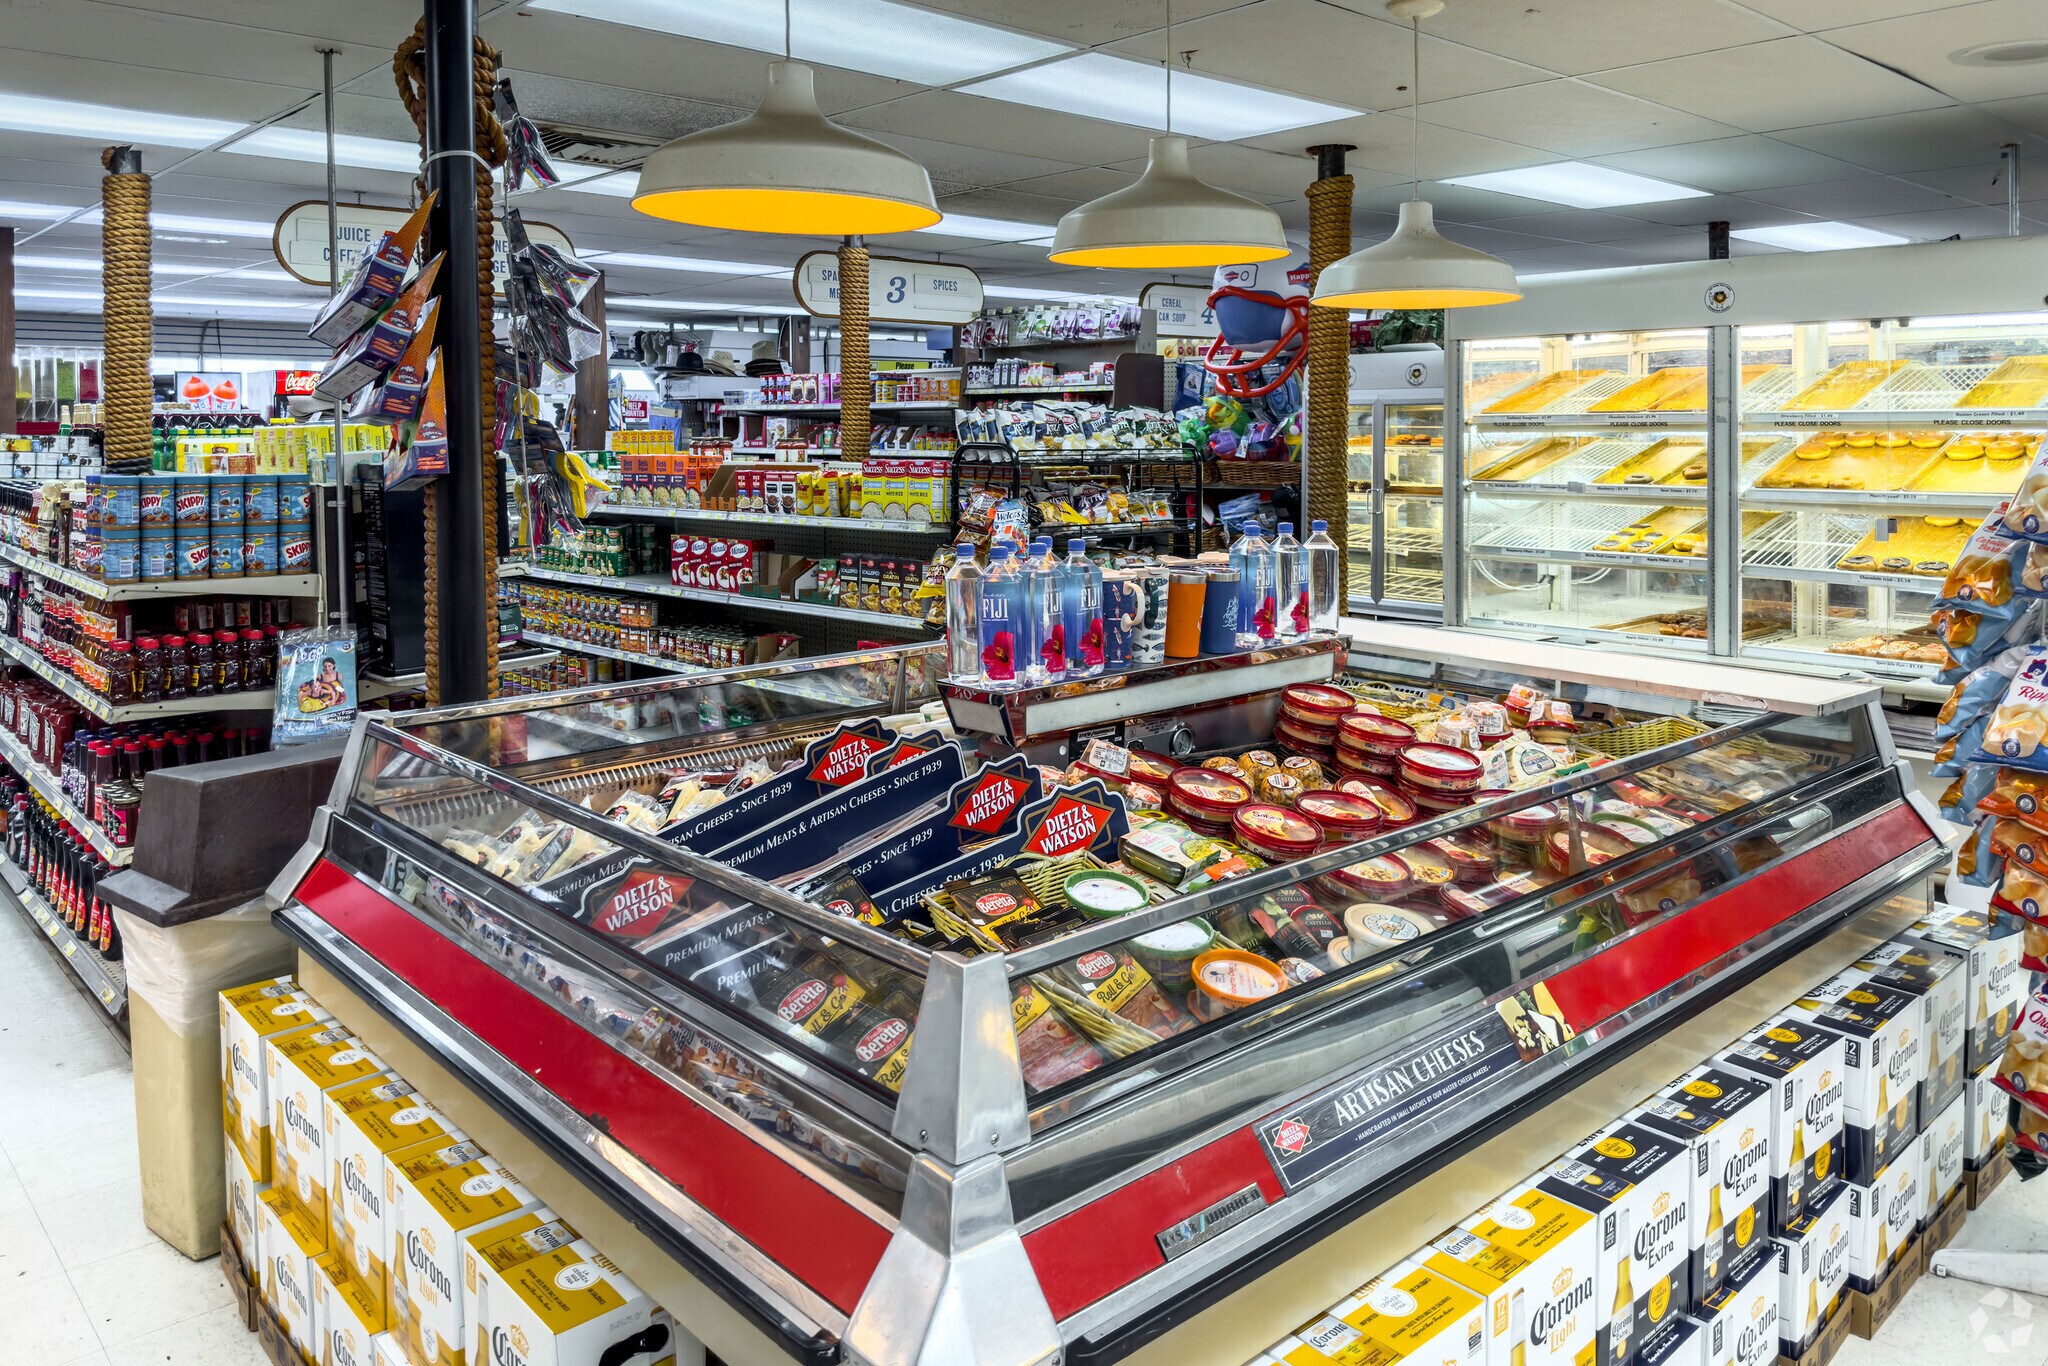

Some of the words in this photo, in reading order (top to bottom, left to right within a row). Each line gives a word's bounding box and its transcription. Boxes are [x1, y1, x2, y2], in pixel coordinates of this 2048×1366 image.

[336, 227, 371, 242] JUICE
[886, 276, 907, 304] 3
[933, 279, 958, 292] SPICES
[1162, 297, 1183, 309] CEREAL
[1200, 306, 1214, 325] 4
[1158, 312, 1170, 322] CAN
[1172, 312, 1187, 323] SOUP
[895, 361, 915, 371] Please
[176, 495, 205, 511] SKIPPY
[1256, 568, 1274, 587] FIJI
[1293, 564, 1308, 582] FIJI
[982, 598, 1009, 619] FIJI
[1043, 592, 1063, 613] FIJI
[1080, 586, 1101, 608] FIJI
[828, 743, 860, 765] DIETZ
[860, 739, 871, 751] &
[971, 785, 1004, 809] DIETZ
[1003, 779, 1013, 793] &
[695, 810, 734, 834] CHEESES
[741, 793, 768, 814] SINCE
[769, 781, 793, 799] 1939
[720, 844, 765, 869] PREMIUM
[766, 827, 797, 851] MEATS
[799, 821, 807, 834] &
[809, 803, 847, 829] ARTISAN
[850, 785, 887, 809] CHEESES
[894, 772, 920, 789] SINCE
[921, 759, 942, 777] 1939
[965, 791, 1015, 828] WATSON
[1045, 809, 1081, 835] DIETZ
[1081, 804, 1093, 820] &
[1252, 809, 1283, 823] Sabra
[881, 840, 908, 864] SINCE
[910, 828, 933, 848] 1939
[1039, 818, 1098, 855] WATSON
[979, 853, 1005, 876] 1939
[548, 873, 596, 899] PREMIUM
[613, 878, 656, 913] DIETZ
[657, 875, 671, 891] &
[605, 889, 675, 932] WATSON
[976, 894, 1016, 914] Beretta
[665, 932, 722, 967] PREMIUM
[725, 913, 764, 940] MEATS
[1076, 953, 1115, 978] Beretta
[1988, 958, 2017, 990] Corona
[777, 979, 827, 1021] Beretta
[1096, 987, 1117, 1004] Roll
[1122, 971, 1135, 986] Go
[1995, 983, 2011, 999] Extra
[822, 1008, 831, 1023] &
[1015, 1001, 1031, 1017] Go
[1939, 1000, 1964, 1037] Corona
[856, 1021, 907, 1062] Beretta
[233, 1043, 258, 1090] Corona
[877, 1058, 900, 1085] Roll
[1889, 1038, 1918, 1081] Corona
[1334, 1066, 1414, 1126] ARTISAN
[1411, 1030, 1486, 1082] CHEESES
[1895, 1067, 1911, 1087] Extra
[1357, 1118, 1391, 1141] HANDCRAFTED
[1396, 1107, 1410, 1120] SMALL
[1409, 1099, 1427, 1113] BATCHES
[1432, 1090, 1442, 1101] OUR
[1442, 1082, 1458, 1095] MASTER
[1457, 1074, 1473, 1086] CHEESE
[1473, 1065, 1489, 1078] MAKERS
[1805, 1081, 1843, 1126] Corona
[285, 1096, 320, 1149] Corona
[1281, 1126, 1295, 1138] DIETZ
[1813, 1112, 1834, 1134] Extra
[1281, 1131, 1305, 1148] WATSON
[1699, 1144, 1707, 1161] 12
[1938, 1130, 1962, 1173] Corona
[1555, 1162, 1583, 1180] Corona
[1724, 1138, 1768, 1190] Corona
[343, 1157, 380, 1219] Corona
[1734, 1173, 1757, 1198] Extra
[1888, 1179, 1917, 1227] Corona
[1606, 1216, 1614, 1233] 12
[1634, 1201, 1686, 1262] Corona
[1894, 1210, 1910, 1233] Extra
[534, 1226, 562, 1248] Corona
[1444, 1235, 1477, 1256] Corona
[407, 1230, 452, 1302] Corona
[1648, 1240, 1674, 1270] Extra
[1818, 1230, 1849, 1283] Corona
[277, 1256, 308, 1317] Corona
[1826, 1264, 1842, 1288] Extra
[419, 1274, 438, 1308] Light
[1496, 1301, 1506, 1318] 12
[1530, 1276, 1593, 1347] Corona
[1310, 1322, 1348, 1348] Corona
[1550, 1314, 1577, 1354] Light
